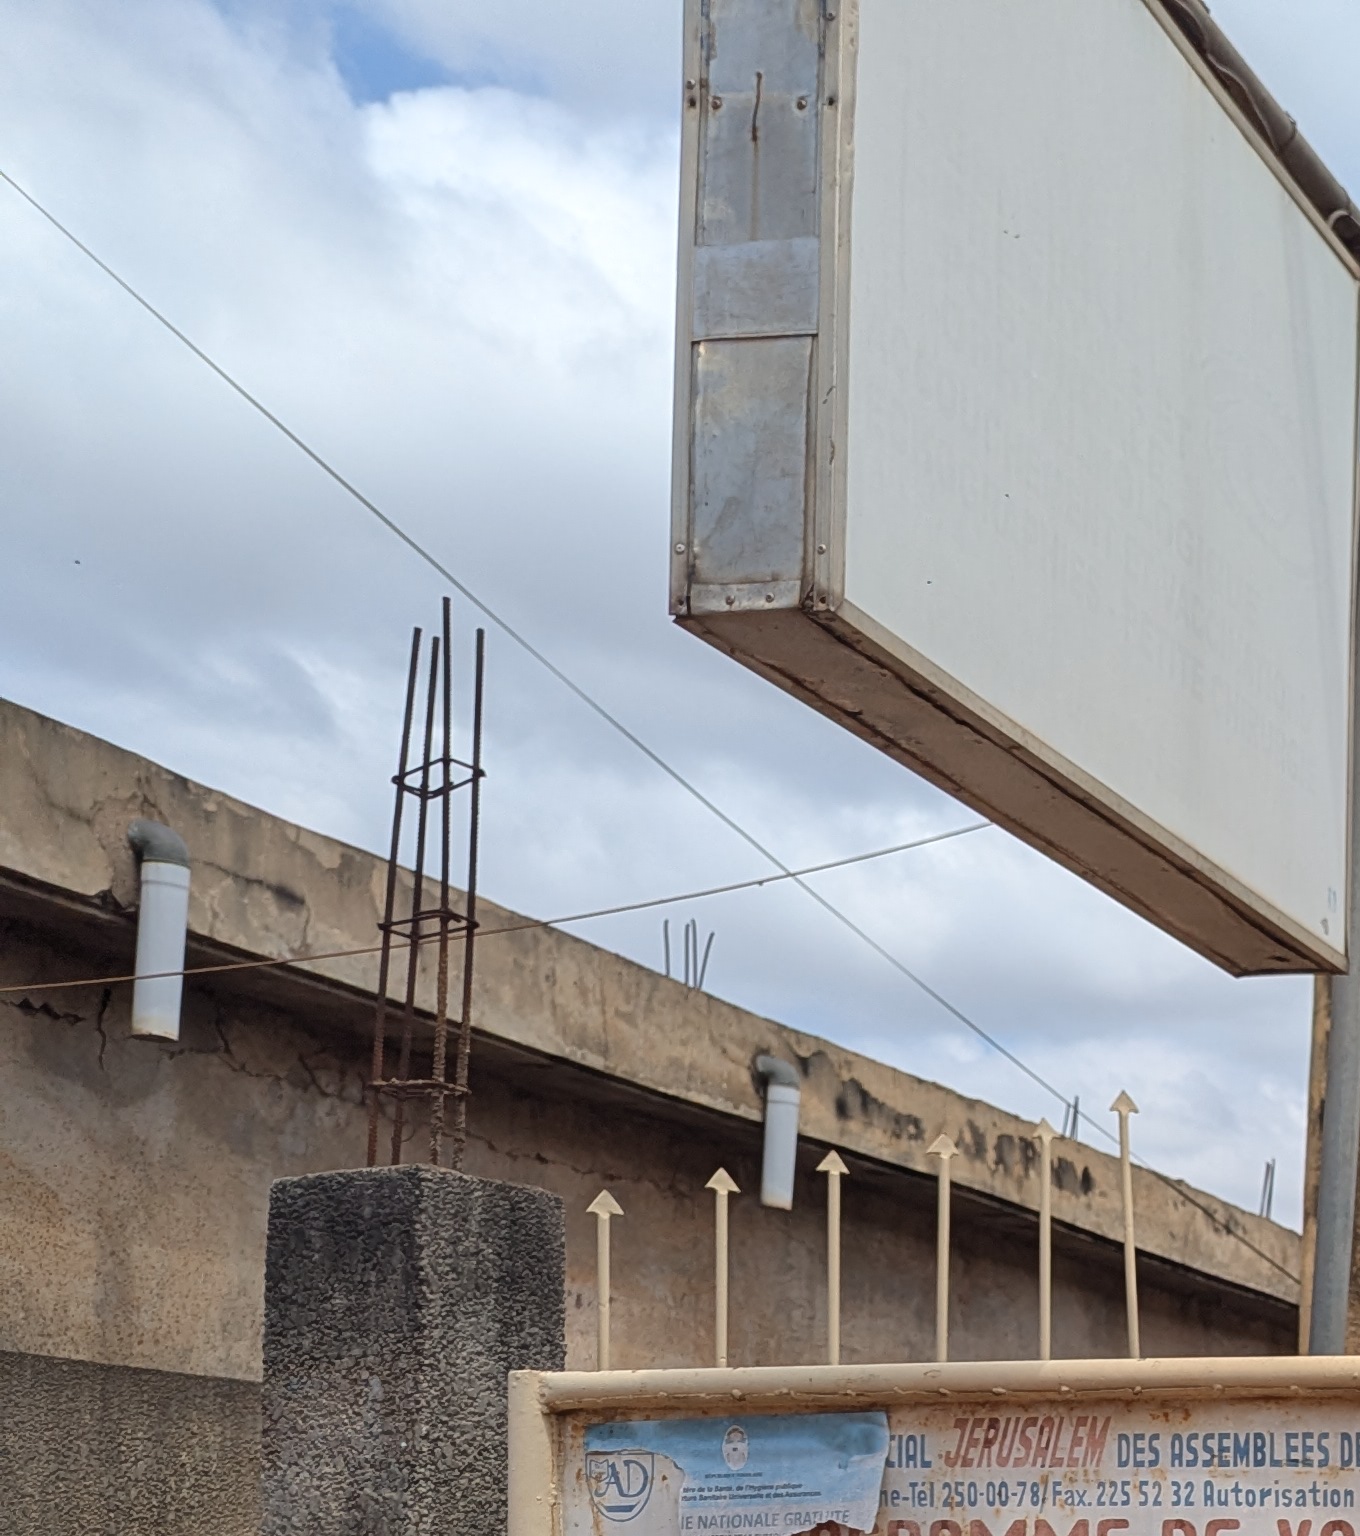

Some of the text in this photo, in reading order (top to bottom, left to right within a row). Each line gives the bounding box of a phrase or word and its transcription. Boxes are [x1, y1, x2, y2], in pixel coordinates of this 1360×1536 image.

[886, 1434, 932, 1469] CIAL
[945, 1415, 1112, 1470] JERUSALEM
[1117, 1432, 1160, 1469] DES
[1170, 1431, 1330, 1469] ASSEMBLEES
[1139, 1480, 1162, 1508] 52
[1170, 1480, 1196, 1508] 32
[1203, 1480, 1354, 1509] Autorisation
[697, 1512, 779, 1530] NATIONALE
